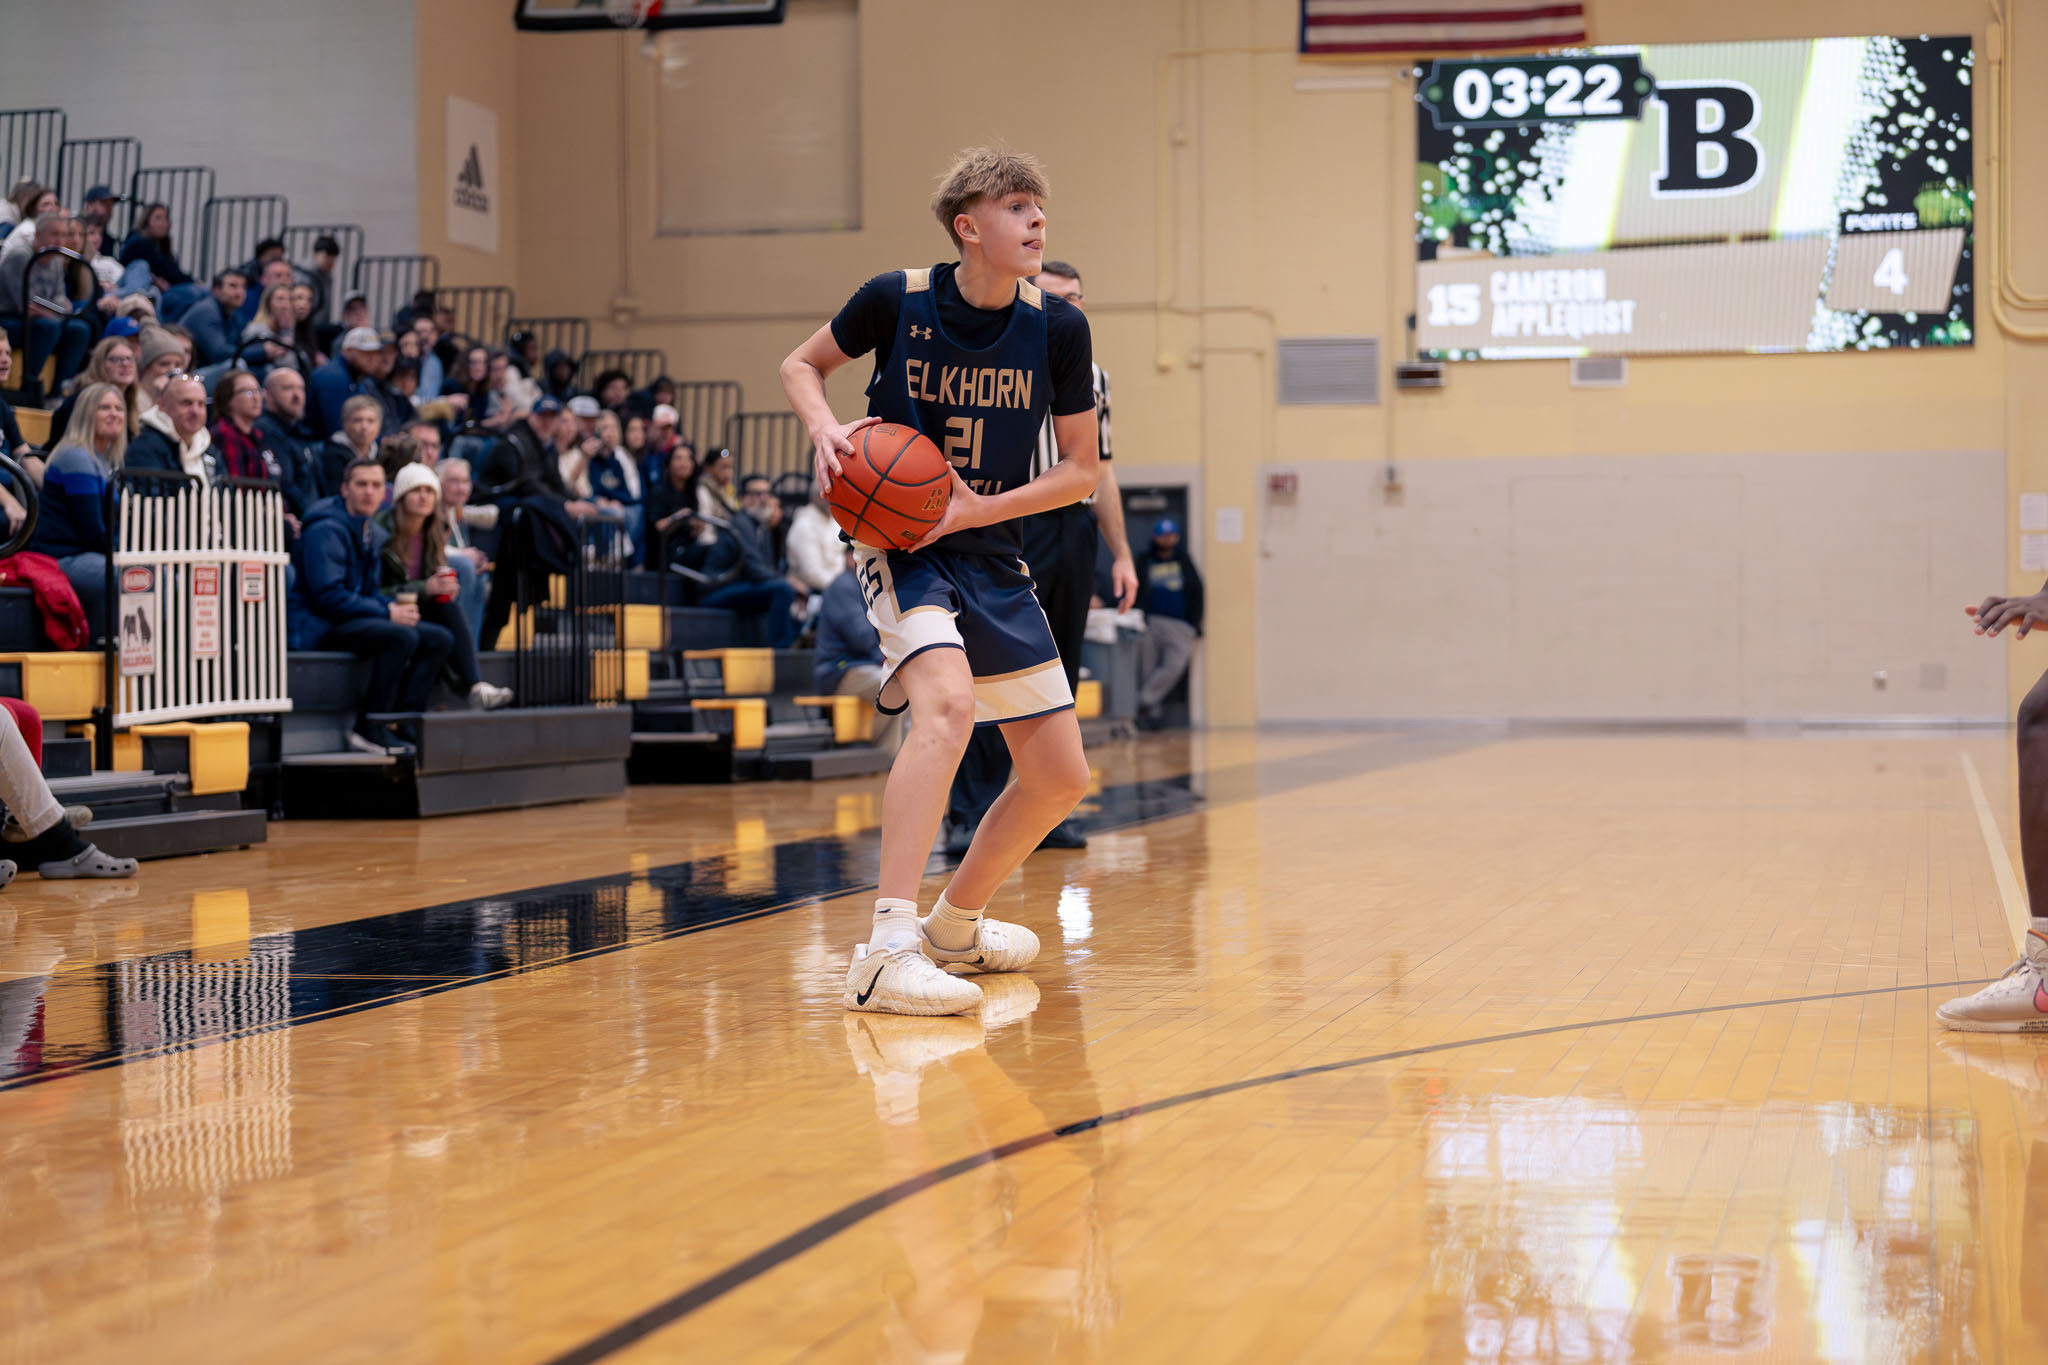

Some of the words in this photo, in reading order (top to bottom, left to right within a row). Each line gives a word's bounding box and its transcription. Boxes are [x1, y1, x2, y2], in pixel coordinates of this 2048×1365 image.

[1453, 64, 1622, 119] 03:22
[1654, 83, 1764, 196] B
[1490, 270, 1605, 301] CAMERON
[1873, 248, 1908, 295] 4
[1427, 283, 1481, 326] 15
[1491, 300, 1636, 338] APPLEQUIST
[906, 359, 1032, 409] ELKHORN
[945, 417, 983, 469] 21
